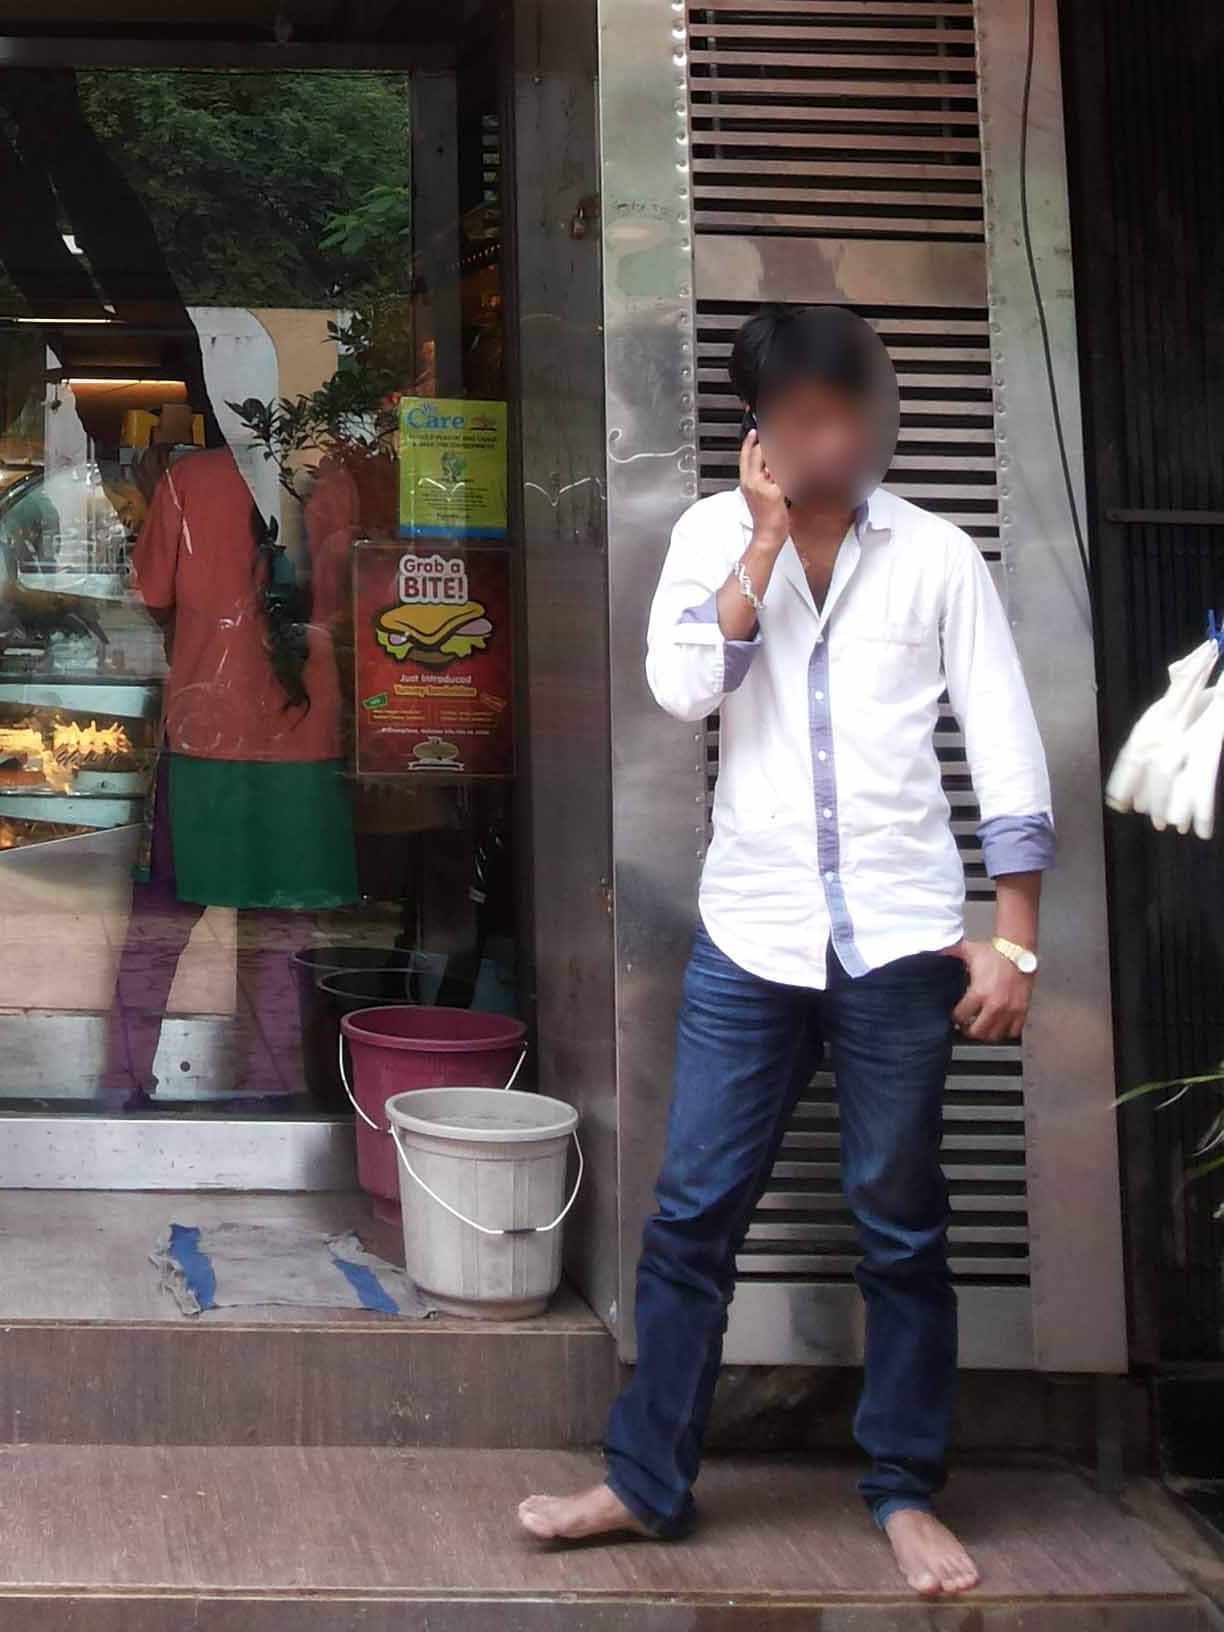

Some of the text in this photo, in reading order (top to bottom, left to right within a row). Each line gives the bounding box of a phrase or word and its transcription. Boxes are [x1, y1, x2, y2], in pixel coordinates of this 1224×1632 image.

[407, 407, 465, 430] Care
[403, 557, 462, 574] Grab a
[403, 576, 465, 600] BITE!
